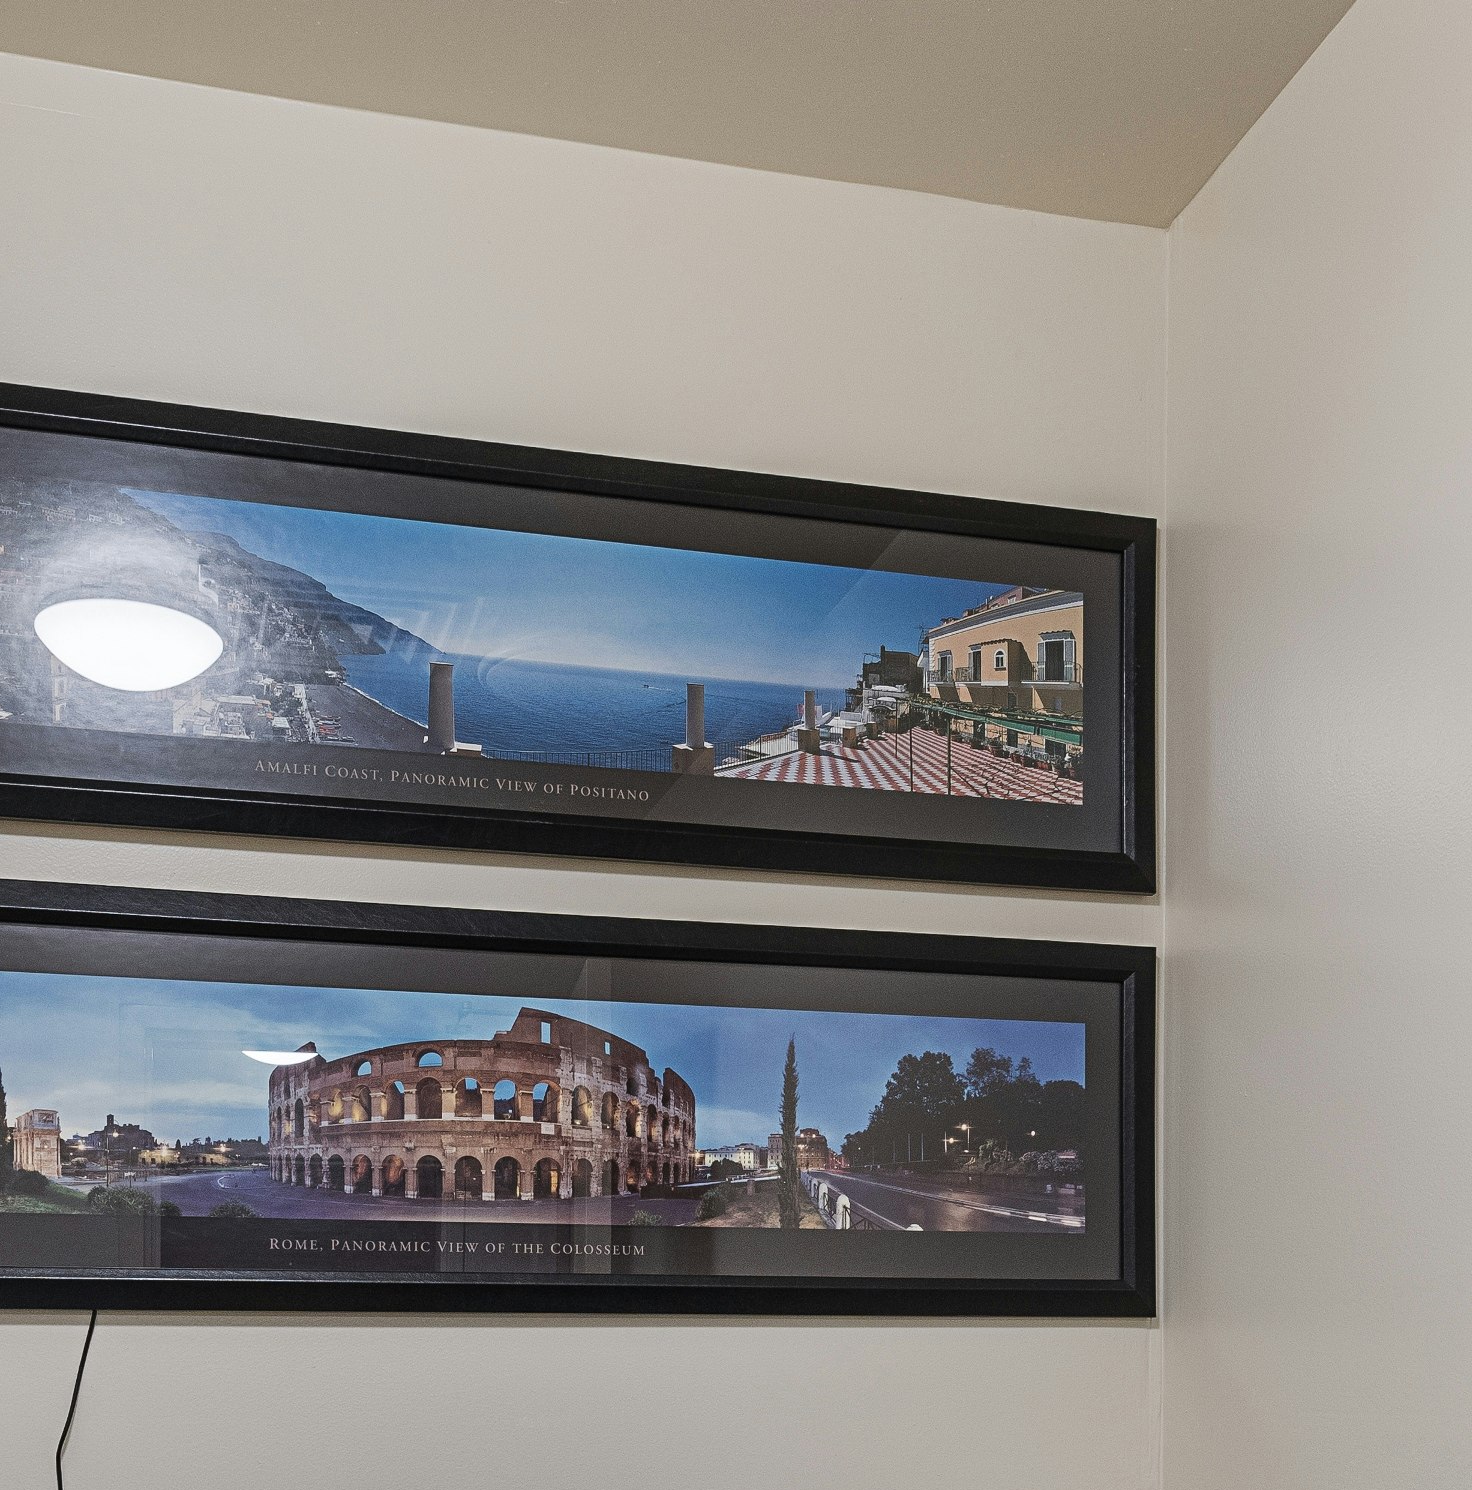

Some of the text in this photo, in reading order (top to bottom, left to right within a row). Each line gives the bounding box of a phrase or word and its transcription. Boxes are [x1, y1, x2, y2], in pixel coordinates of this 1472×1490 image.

[255, 760, 649, 801] AMALFI COAST, PANORAMIC VIEW OF POSITANO
[269, 1238, 645, 1256] ROME, PANORAMIC VIEW OF THE COLOSSEUM
